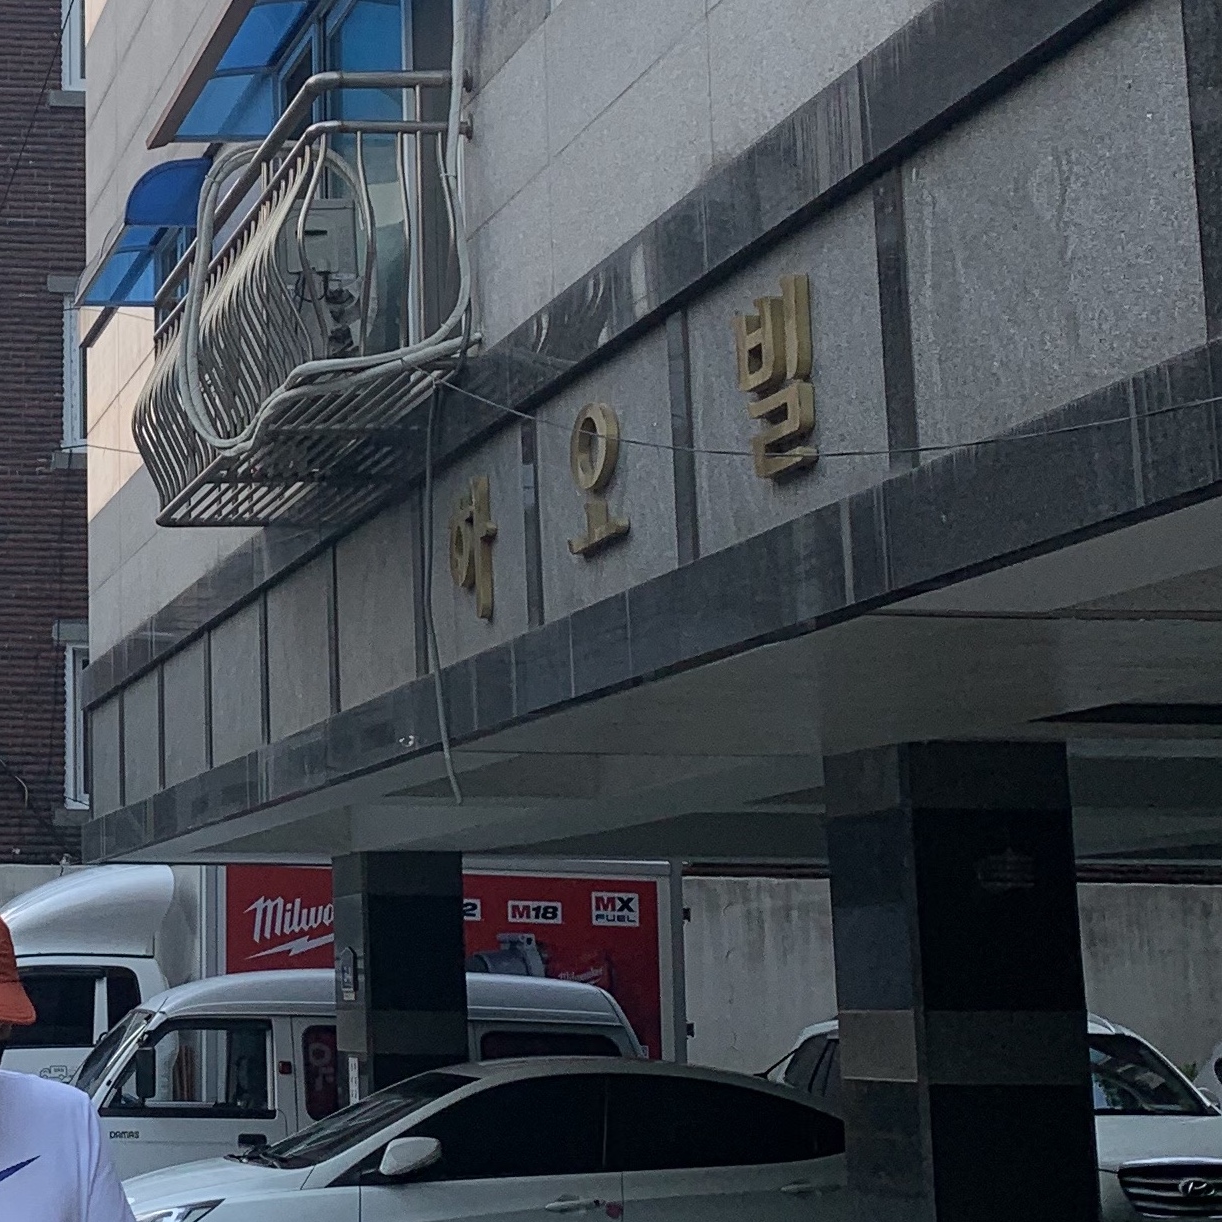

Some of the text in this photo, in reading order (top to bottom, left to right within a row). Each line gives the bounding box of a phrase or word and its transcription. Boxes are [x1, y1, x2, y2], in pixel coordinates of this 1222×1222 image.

[595, 896, 635, 913] MX
[511, 905, 559, 921] M18
[595, 914, 637, 923] FUEL
